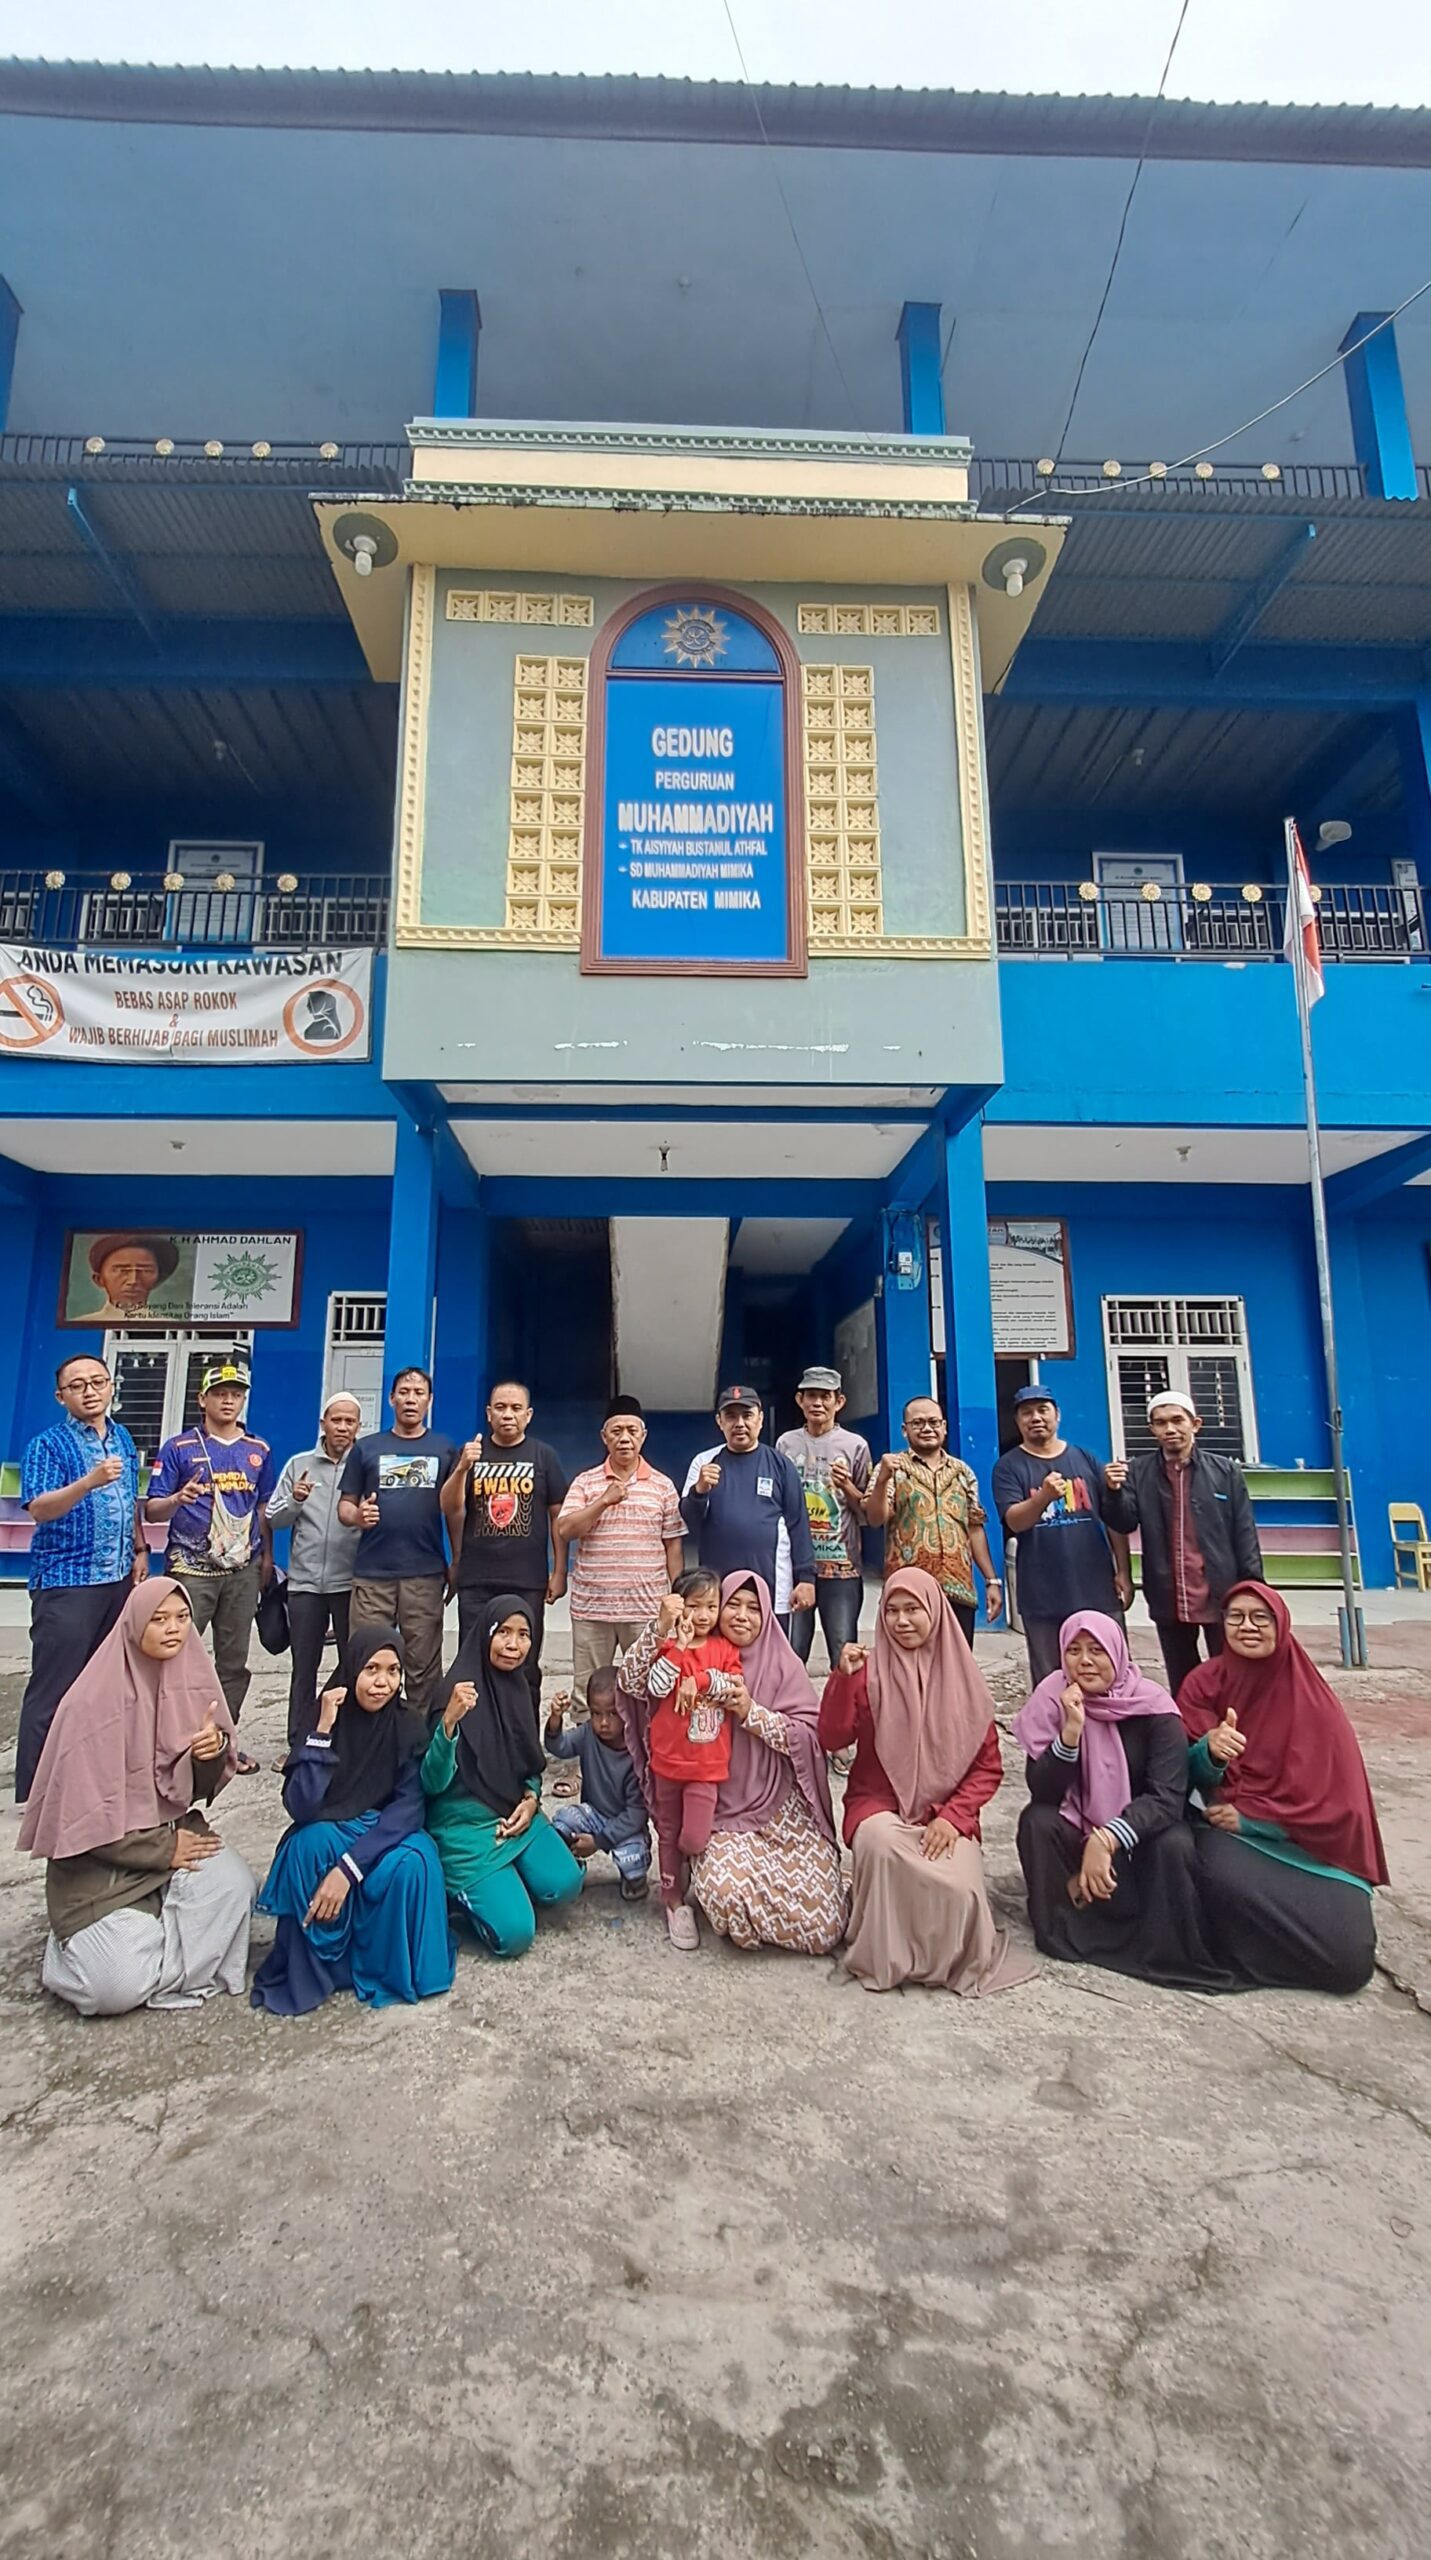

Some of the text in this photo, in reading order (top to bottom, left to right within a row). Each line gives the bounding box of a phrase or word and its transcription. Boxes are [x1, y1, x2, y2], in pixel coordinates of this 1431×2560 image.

[651, 727, 733, 758] GEDUNG
[655, 771, 735, 791] PERGURUAN
[618, 802, 773, 834] MUHAMMADIYAH
[631, 839, 768, 856] TK AISYIYAH BUSTANUL ATHFAL
[630, 862, 754, 879] SD MUHAMMADIYAH MIMIKA
[632, 889, 761, 909] KABUPATEN MIMIKA
[18, 949, 78, 974] ANDA
[115, 990, 238, 1010] BEBAS ASAP ROKOK
[169, 1013, 179, 1027] &
[68, 1025, 279, 1049] WAJIB BERHIJAB BAGI MUSLIMAH
[193, 1236, 238, 1245] AHMAD
[240, 1236, 291, 1245] DAHLAN
[474, 1477, 534, 1495] EWAKO
